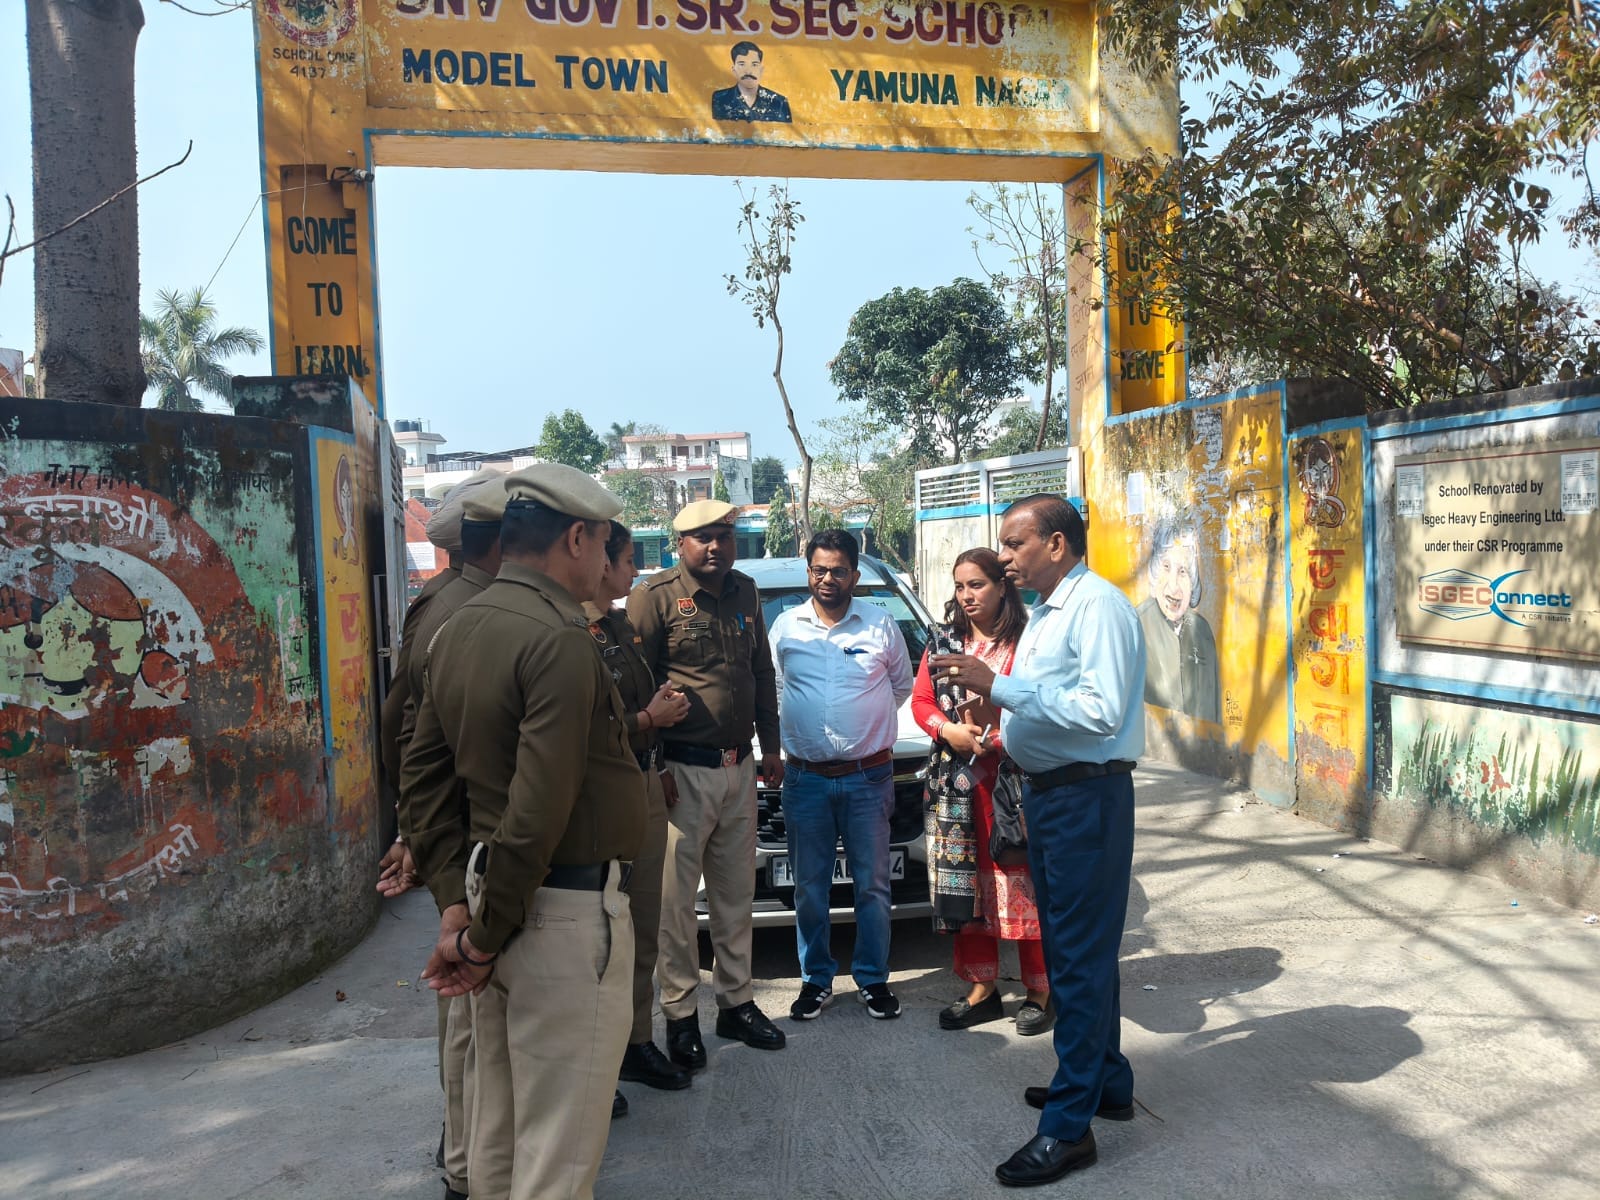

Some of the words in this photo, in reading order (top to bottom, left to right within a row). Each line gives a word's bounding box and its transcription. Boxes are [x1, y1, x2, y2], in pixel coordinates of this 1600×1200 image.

[675, 0, 761, 33] SR.
[770, 0, 875, 38] SEC.
[885, 0, 1051, 45] SCHO
[402, 48, 536, 88] MODEL
[555, 55, 669, 93] TOWN
[831, 69, 960, 106] YAMUNA
[287, 215, 357, 255] COME
[307, 281, 343, 317] TO
[1438, 484, 1471, 498] School
[1473, 480, 1528, 496] Renovated
[1530, 480, 1543, 496] by
[1421, 513, 1446, 528] Isgec
[1448, 512, 1477, 527] Heavy
[1479, 509, 1542, 527] Engineering
[1544, 508, 1566, 523] Ltd.
[1424, 540, 1450, 552] under
[1452, 539, 1474, 552] their
[1476, 539, 1498, 552] CSR
[1501, 539, 1563, 556] Programme
